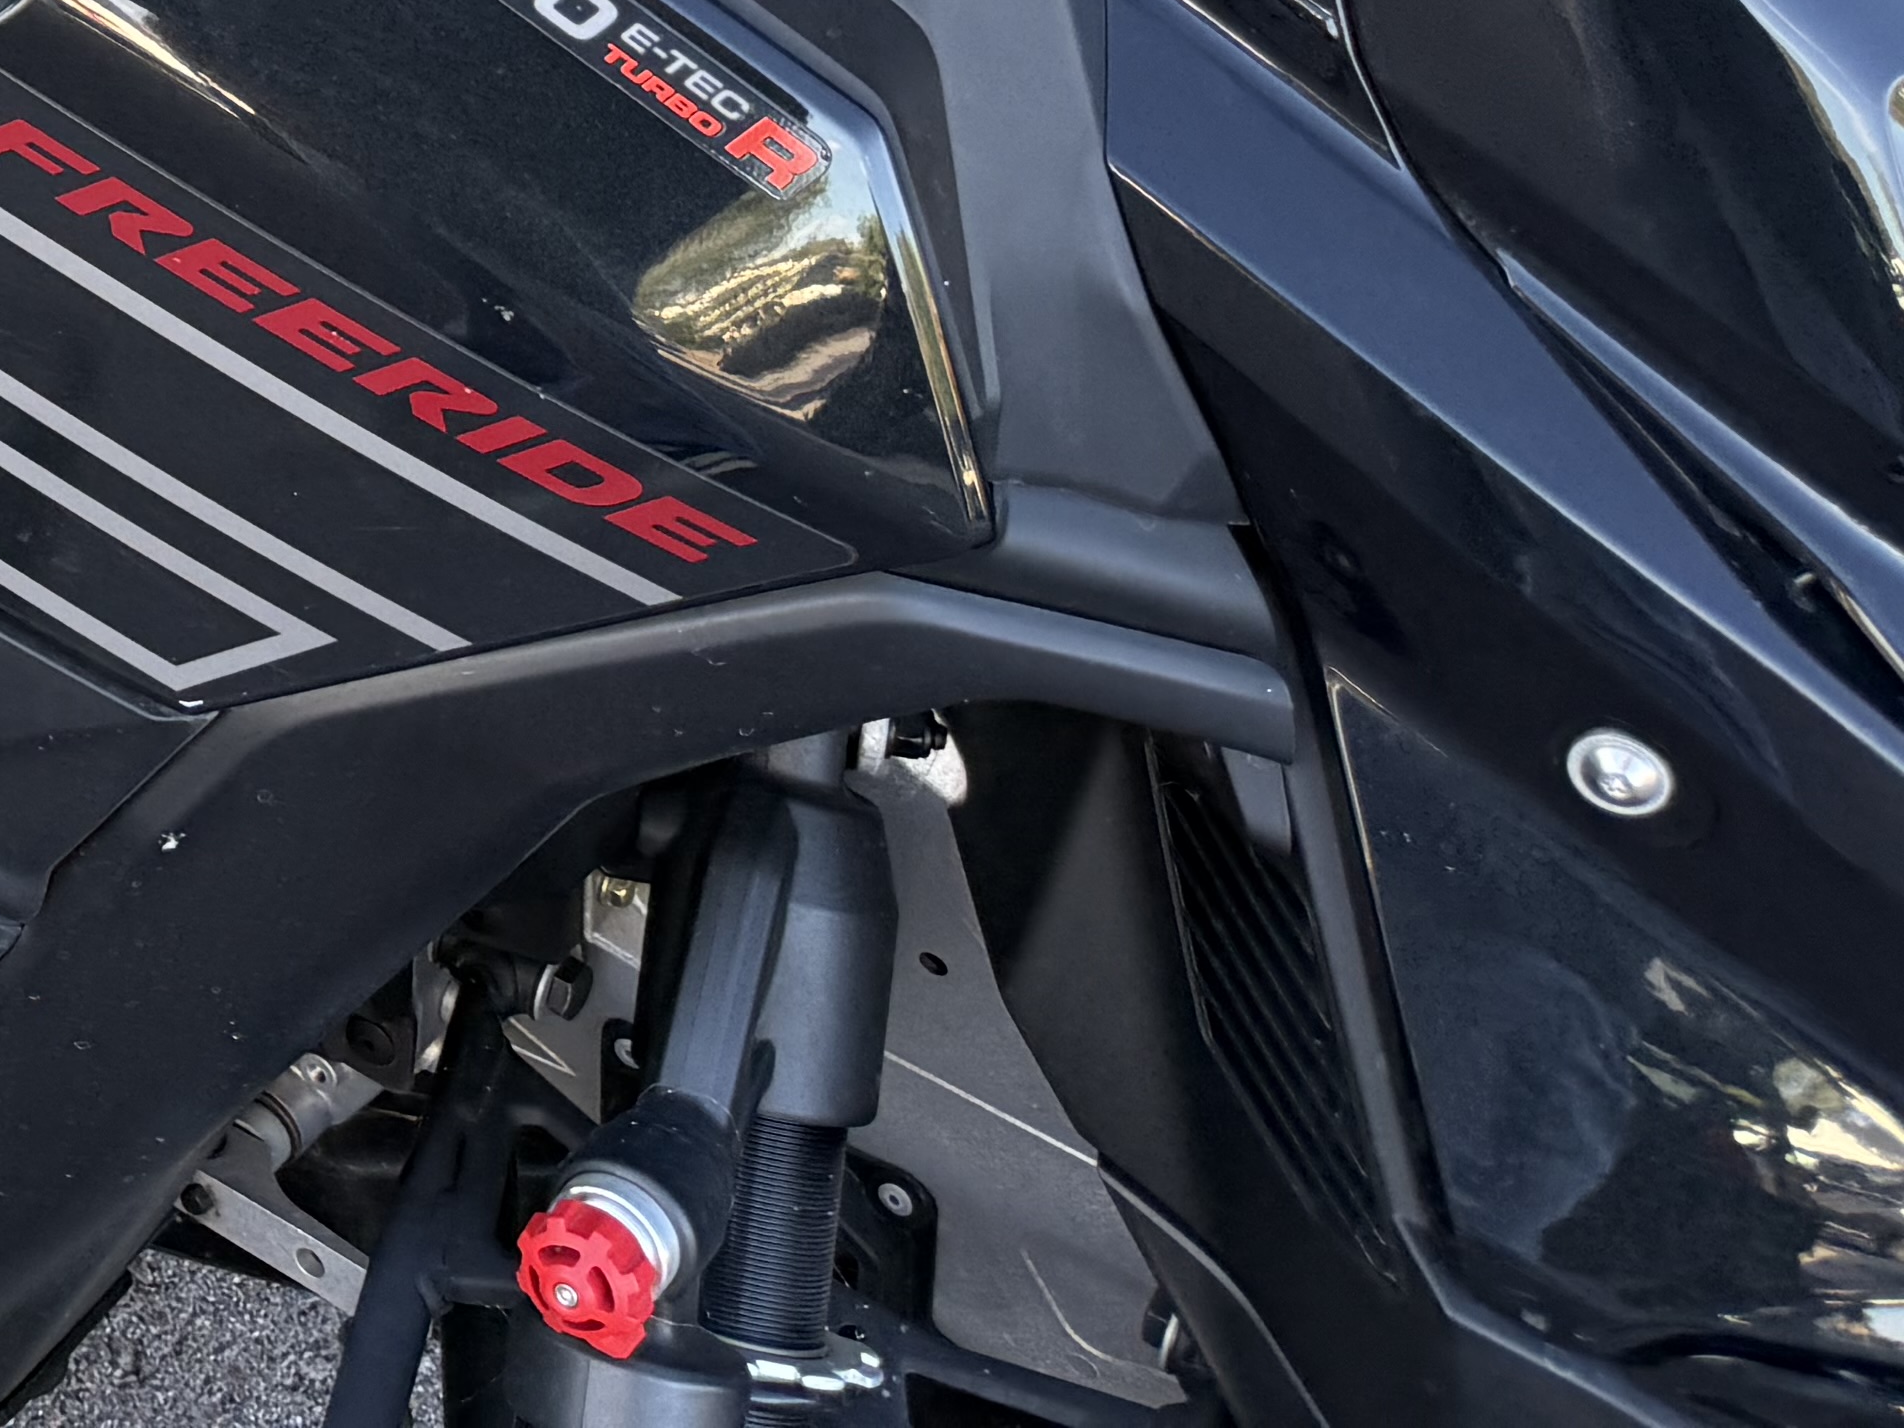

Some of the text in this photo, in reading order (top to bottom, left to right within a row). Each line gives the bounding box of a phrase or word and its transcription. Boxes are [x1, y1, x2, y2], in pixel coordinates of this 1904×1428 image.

[603, 42, 724, 138] TURBO
[621, 23, 750, 121] E-TEC
[724, 116, 819, 191] R
